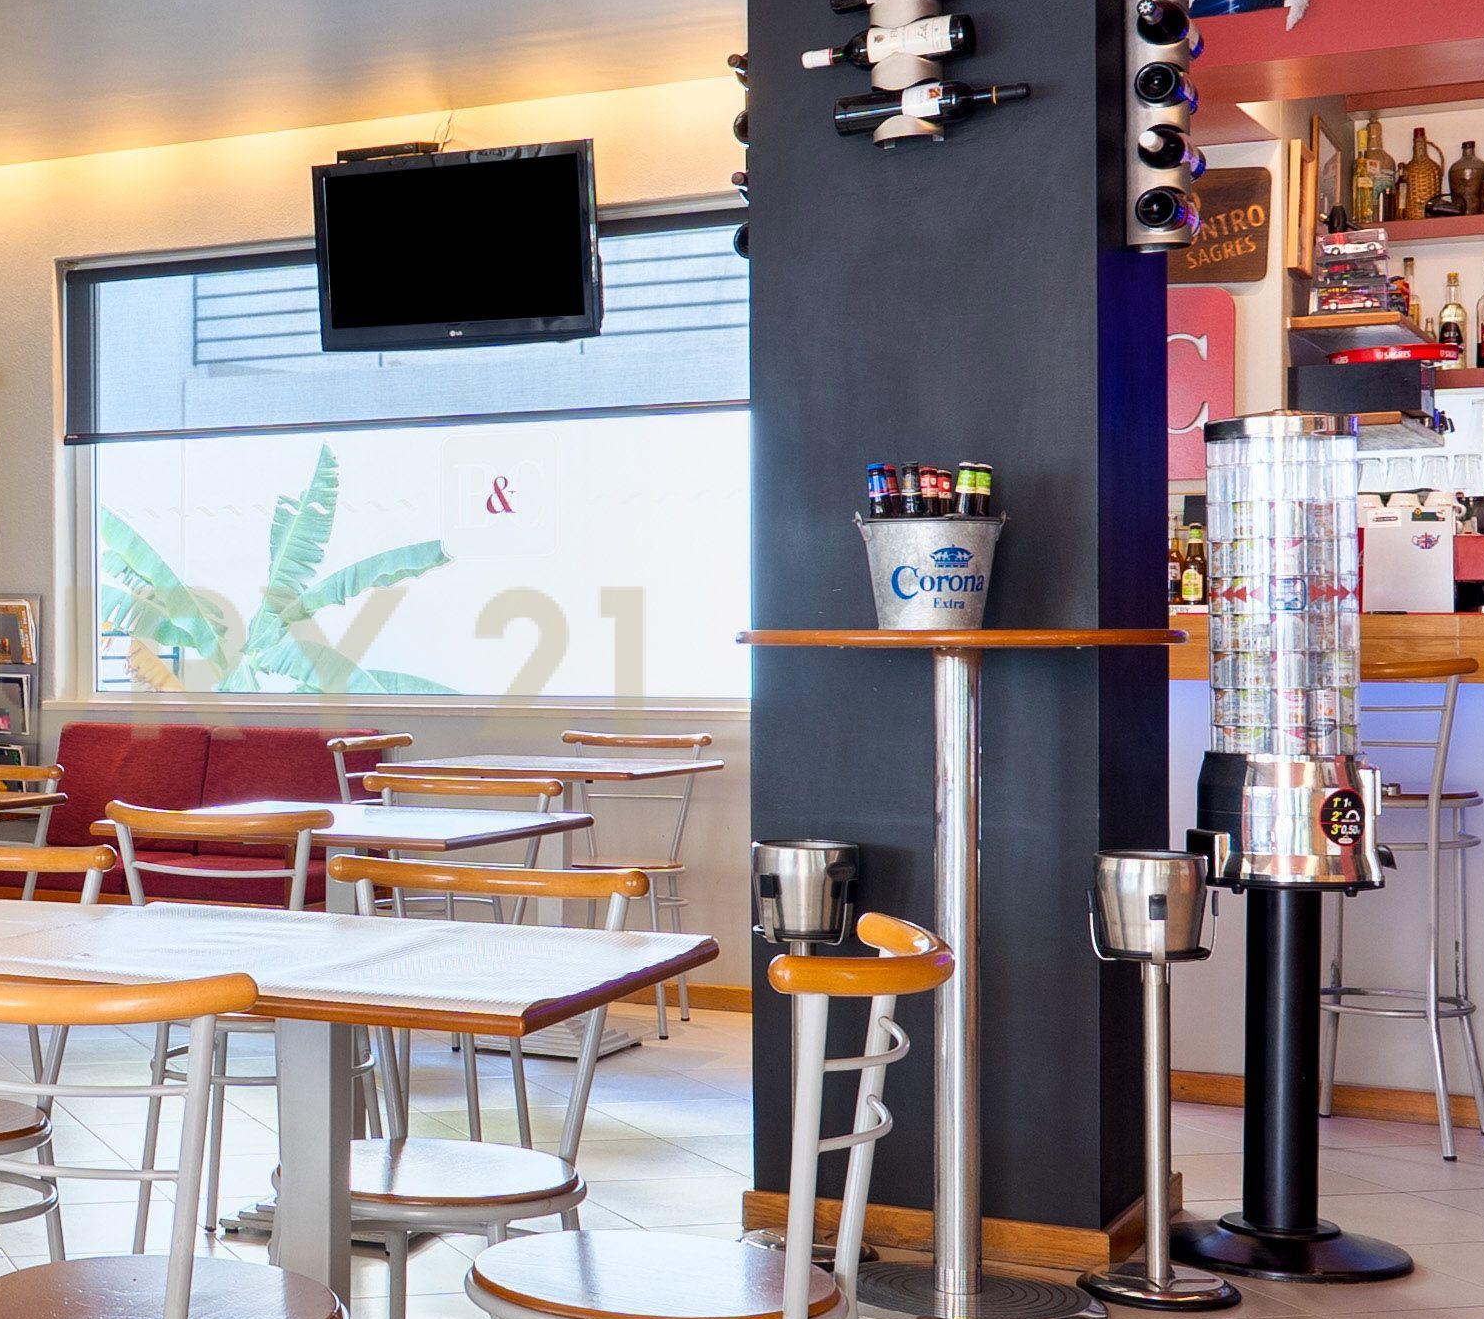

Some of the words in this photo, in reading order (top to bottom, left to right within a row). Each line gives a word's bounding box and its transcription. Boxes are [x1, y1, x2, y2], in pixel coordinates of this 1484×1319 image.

[1191, 203, 1266, 244] NTRO
[1185, 234, 1257, 270] SAGRES
[891, 565, 985, 600] Corona
[933, 597, 965, 610] Extra
